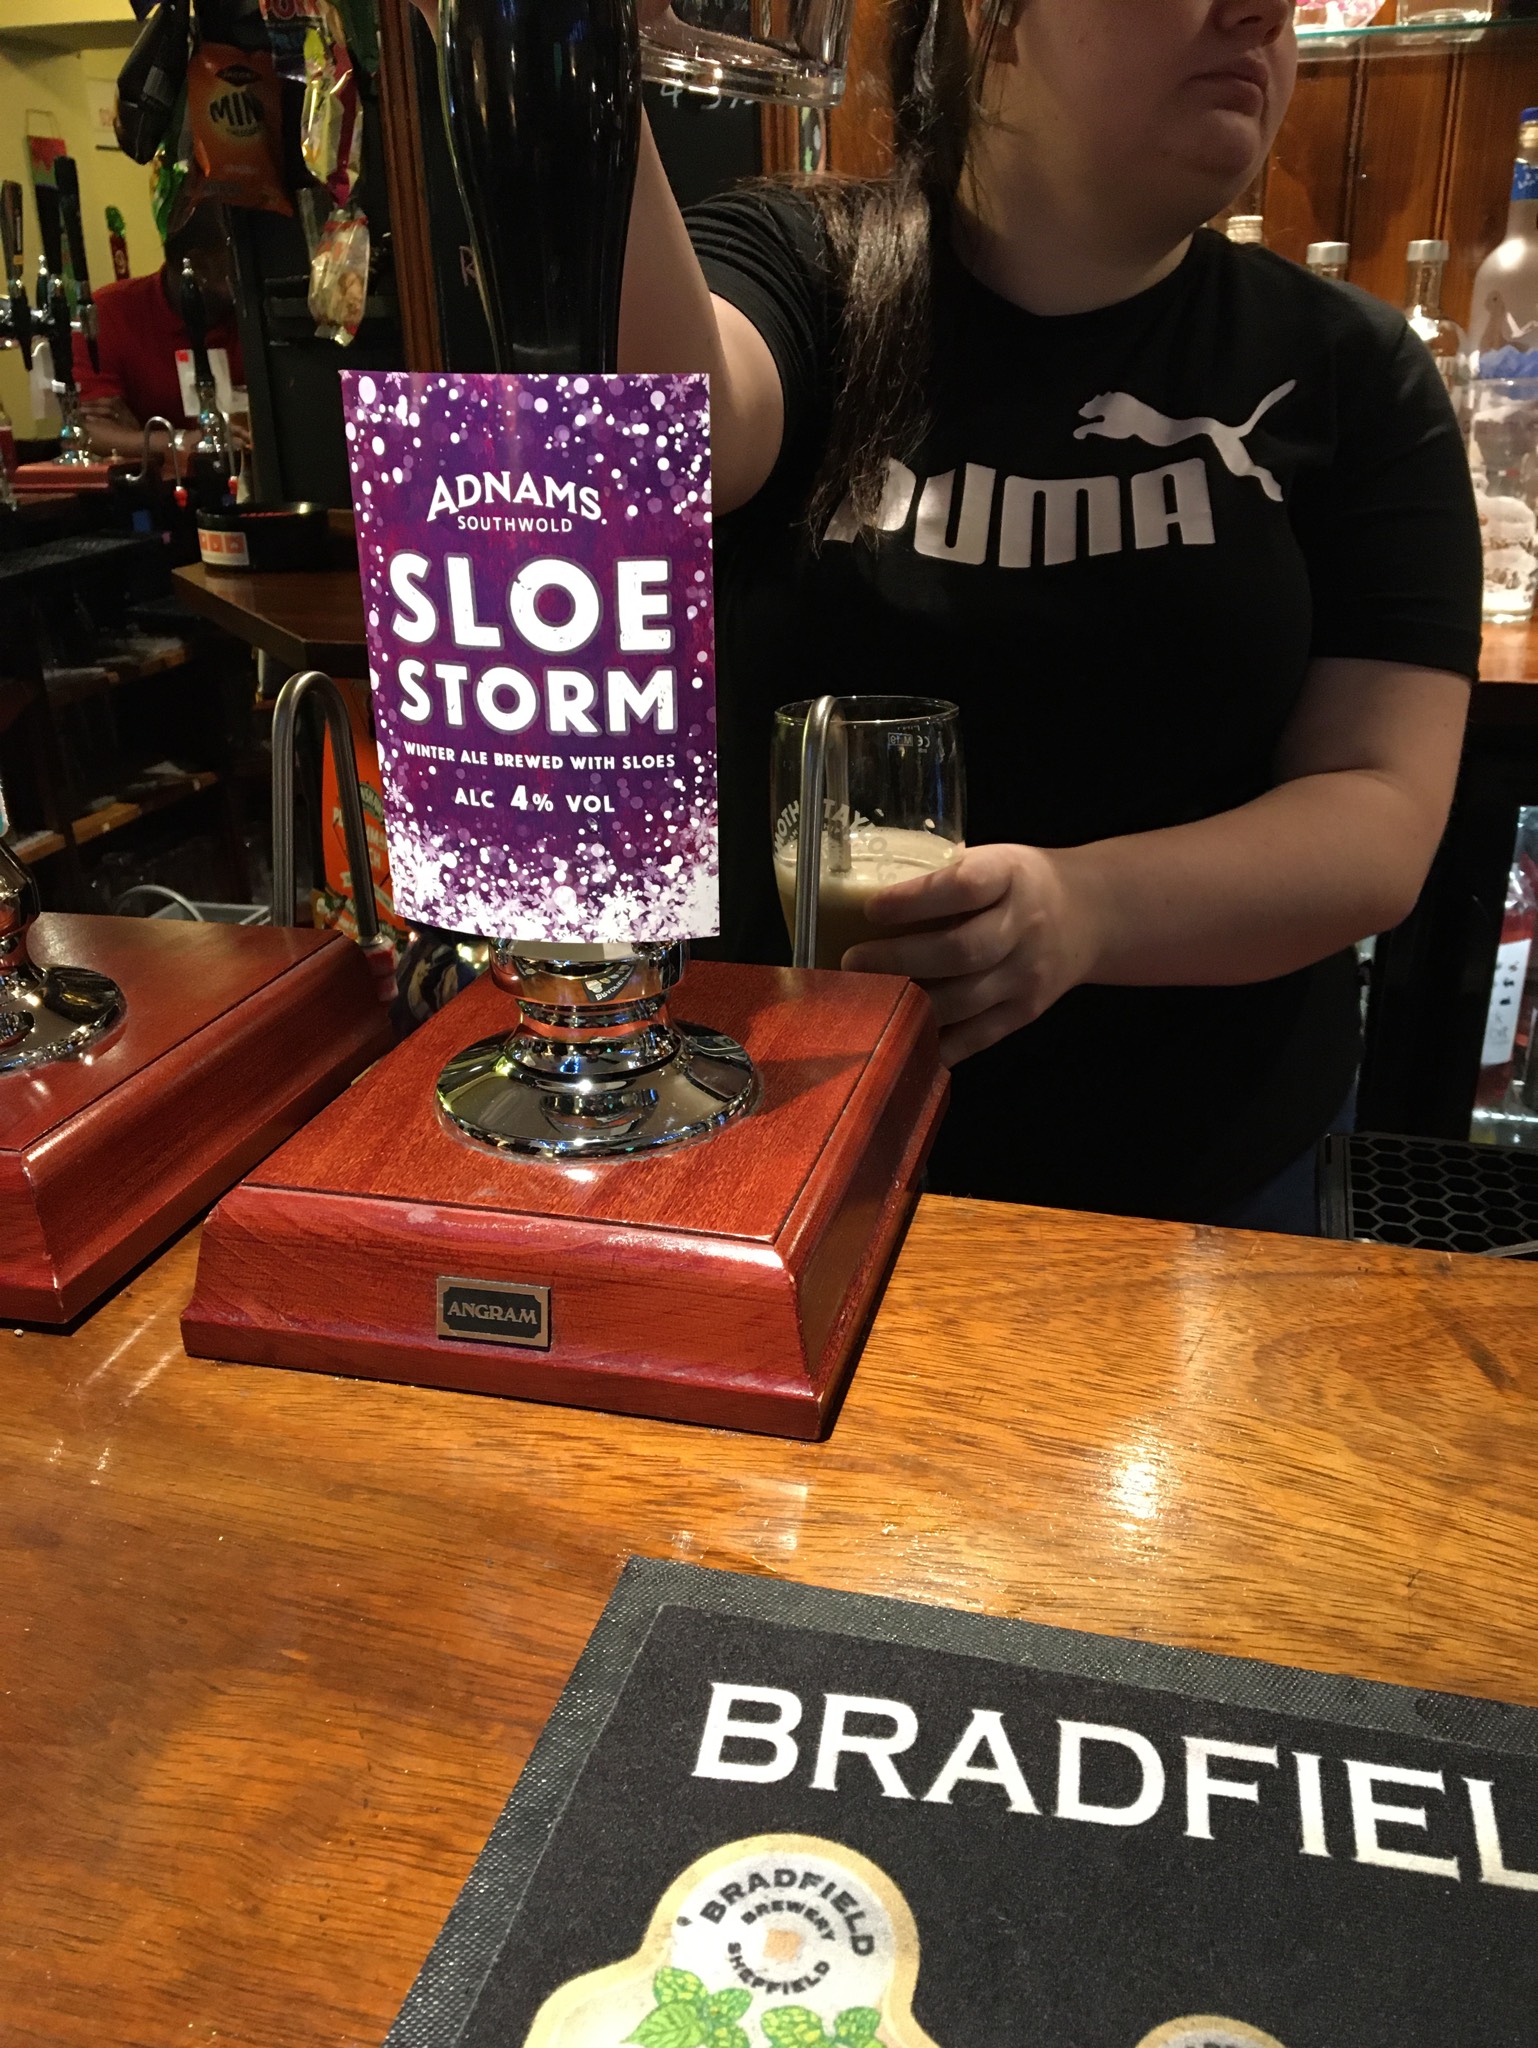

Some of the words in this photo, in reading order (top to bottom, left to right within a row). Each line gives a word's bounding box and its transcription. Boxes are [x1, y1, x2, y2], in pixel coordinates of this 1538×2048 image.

[426, 471, 602, 522] ADNAMS
[823, 456, 1216, 568] PUMA
[457, 515, 573, 532] SOUTHWOLD
[389, 551, 673, 653] SLOE
[397, 658, 677, 735] STORM
[403, 740, 456, 762] WINTER
[460, 750, 488, 766] ALE
[494, 752, 564, 769] BREWED
[569, 756, 615, 770] WITH
[622, 753, 676, 770] SLOES
[454, 787, 495, 809] ALC
[510, 784, 554, 812] 4%
[565, 795, 616, 813] VOL
[773, 800, 801, 852] MOTH
[447, 1301, 538, 1325] ANGRAM
[691, 1682, 1538, 1891] BRADFIEL
[699, 1868, 875, 1957] BRADFIELD
[741, 1899, 836, 1942] BREWERY
[728, 1942, 830, 1995] SHEFFIELD
